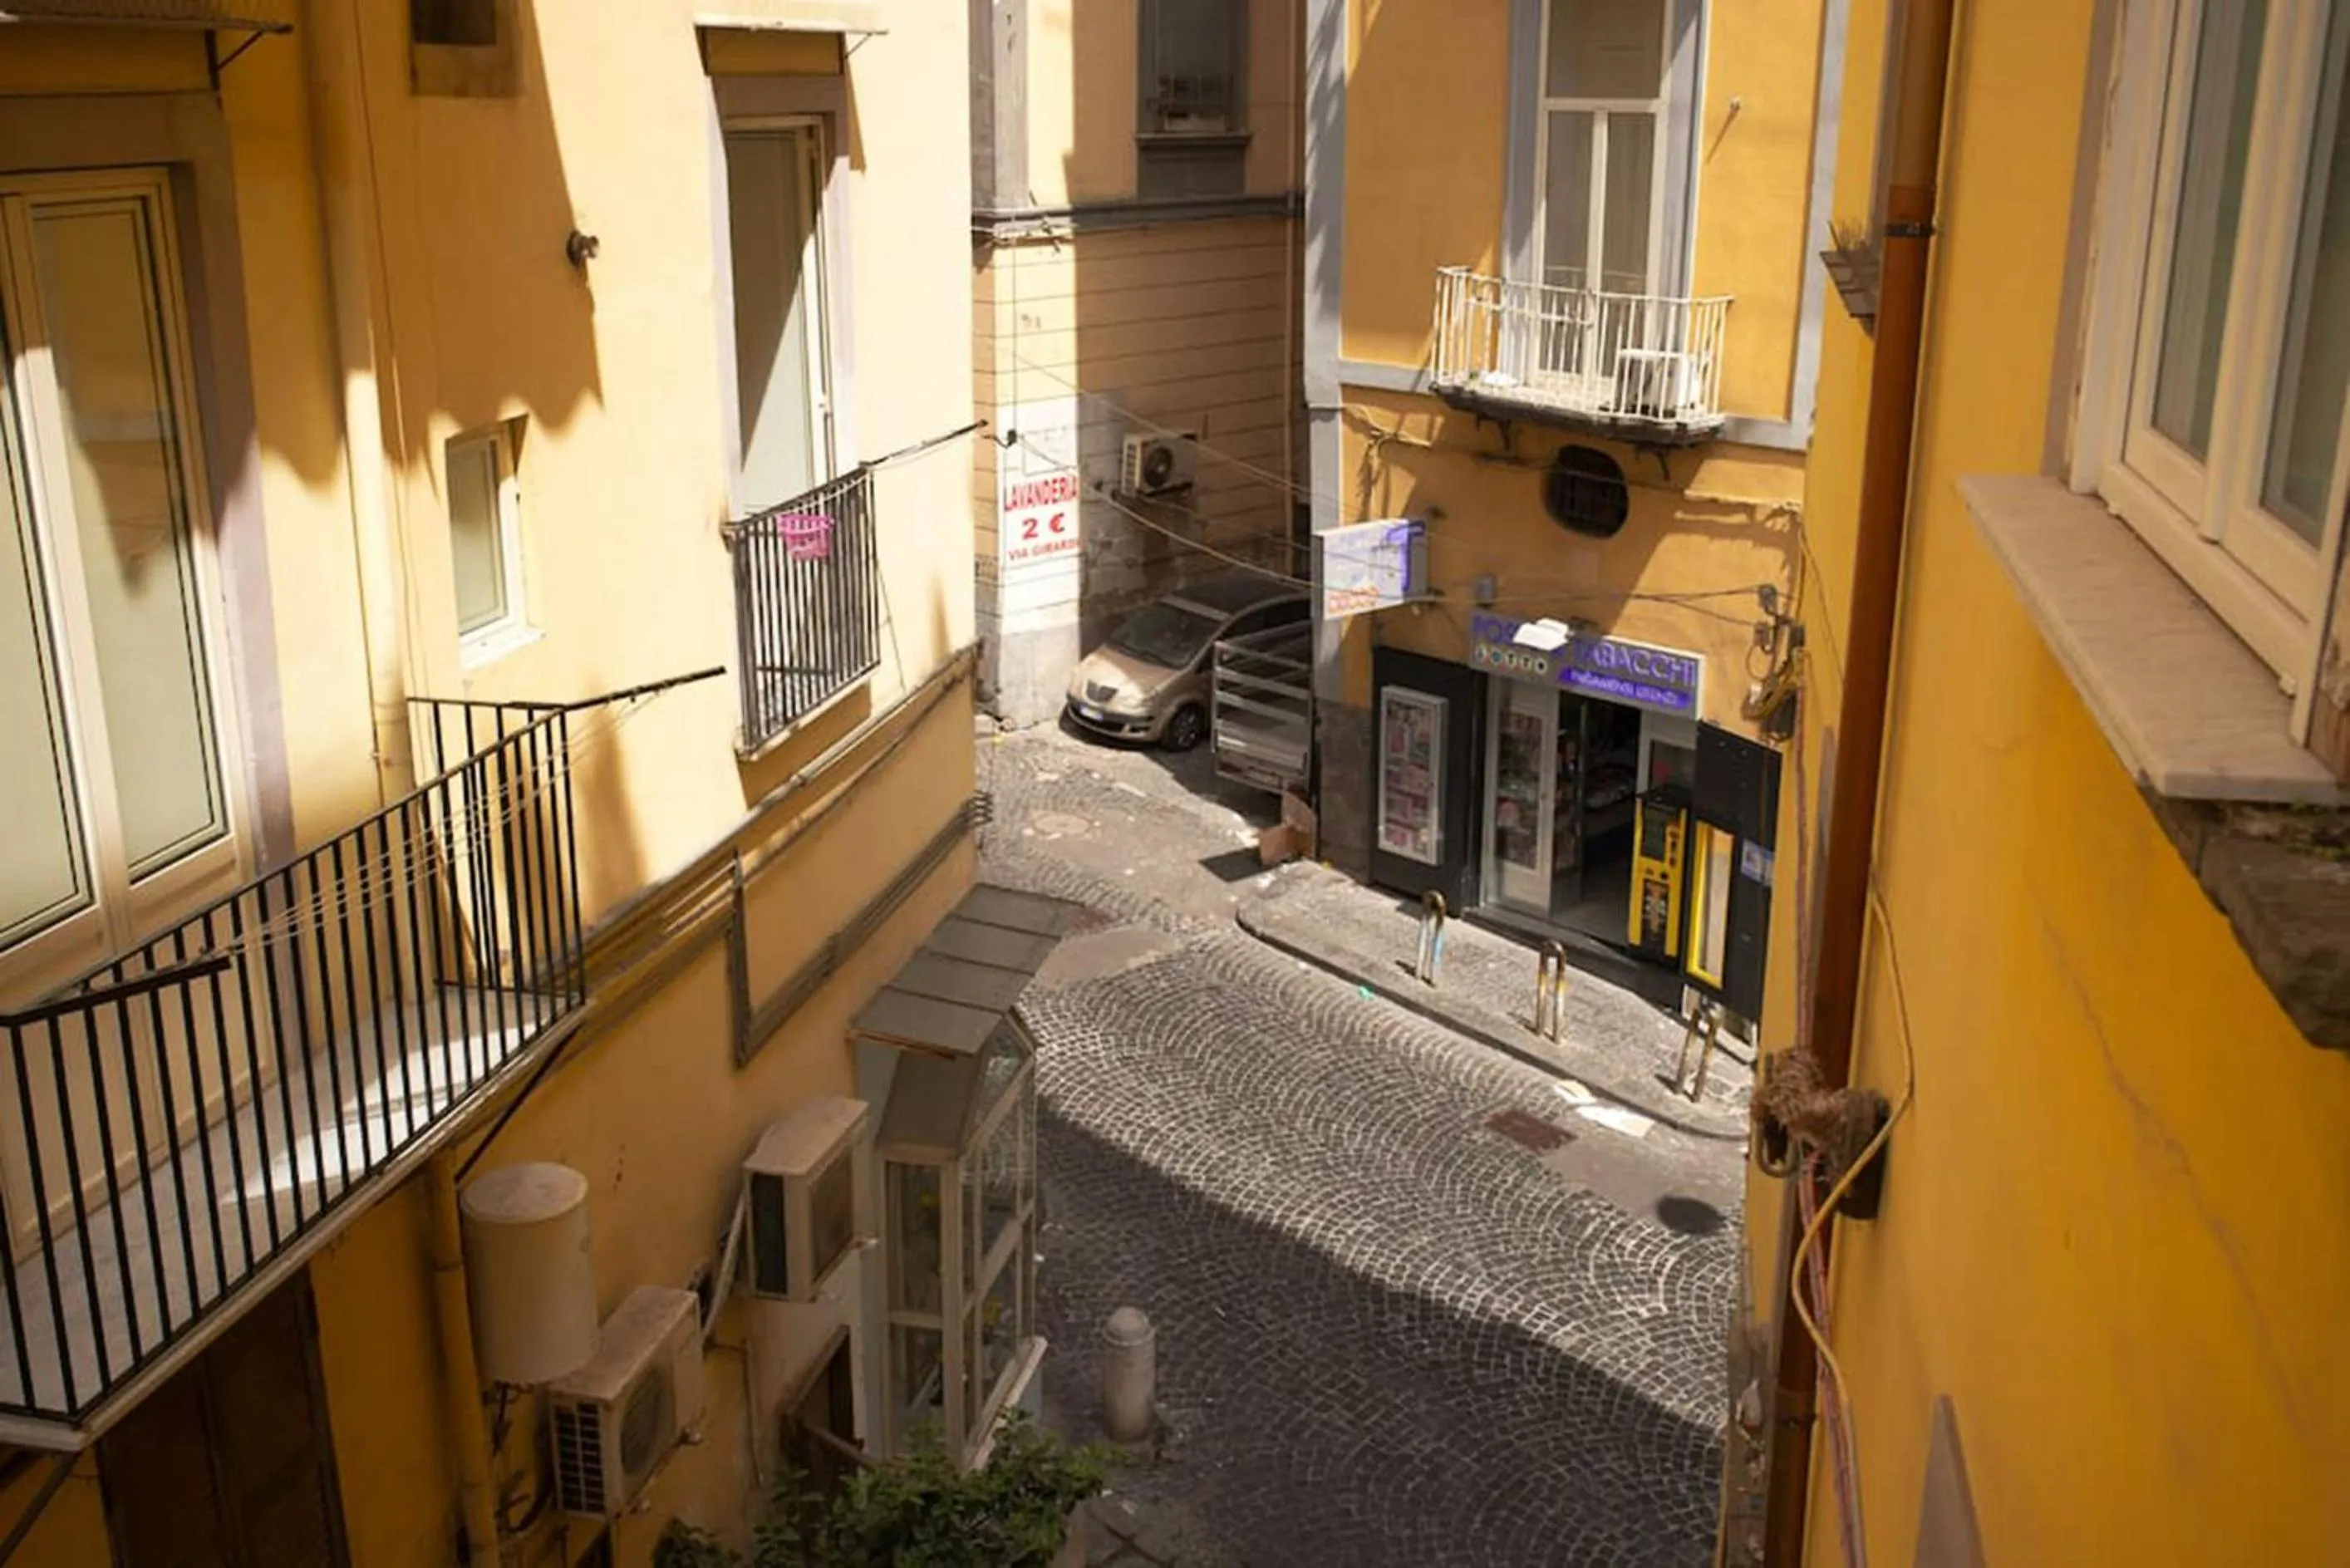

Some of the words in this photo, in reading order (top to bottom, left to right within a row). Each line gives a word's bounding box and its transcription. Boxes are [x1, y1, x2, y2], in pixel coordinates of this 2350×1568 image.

[1003, 474, 1080, 512] LAVANDERIA
[1022, 518, 1039, 540] 2
[1008, 548, 1029, 561] VIA
[1573, 637, 1697, 687] TABACCHI
